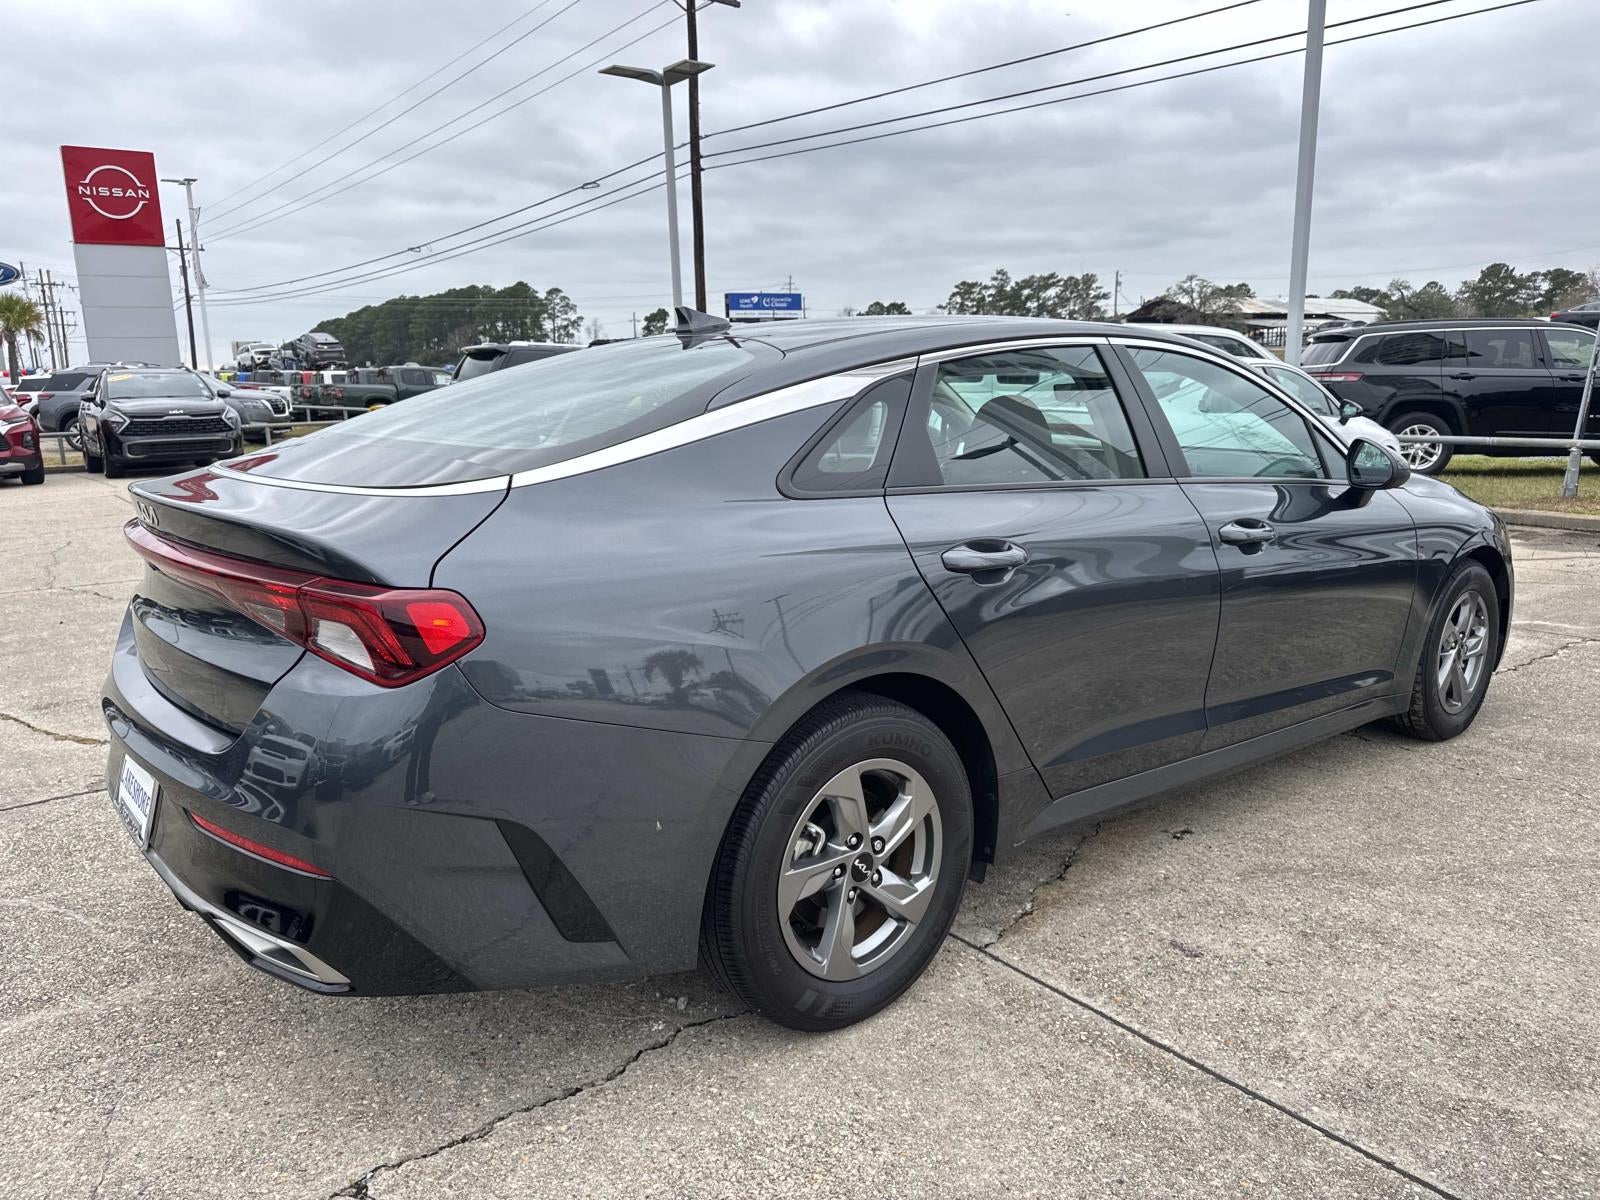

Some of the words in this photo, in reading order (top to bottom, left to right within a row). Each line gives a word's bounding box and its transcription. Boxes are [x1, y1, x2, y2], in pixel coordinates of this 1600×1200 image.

[78, 185, 150, 199] NISSAN
[867, 733, 932, 757] KUMHO
[854, 858, 871, 877] KIA
